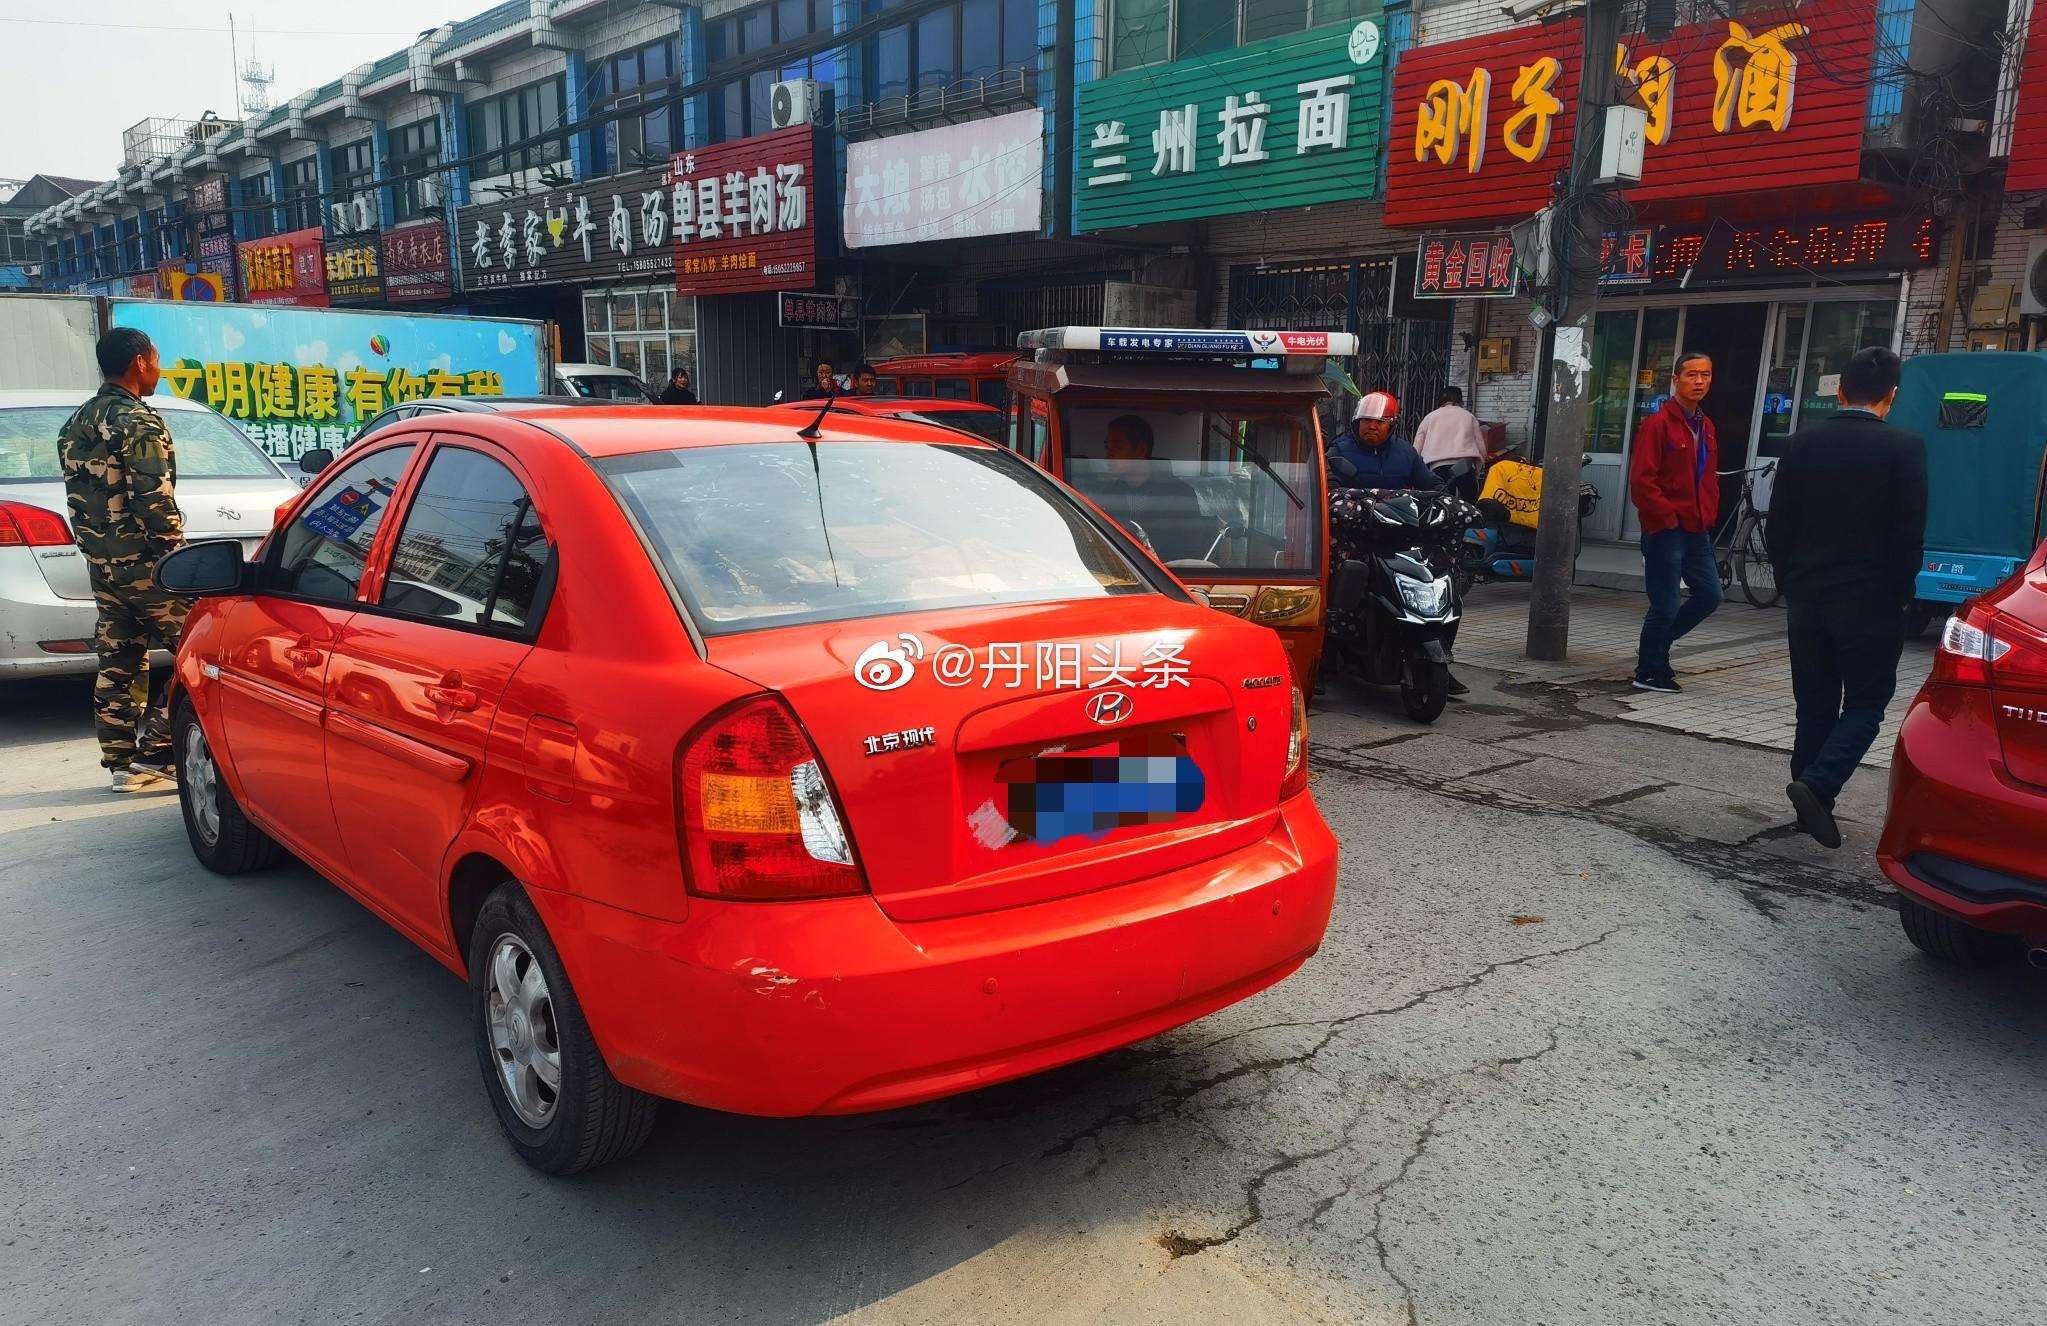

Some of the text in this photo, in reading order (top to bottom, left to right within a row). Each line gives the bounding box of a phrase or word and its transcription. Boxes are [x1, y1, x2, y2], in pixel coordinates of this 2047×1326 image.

[1088, 75, 1355, 186] 兰州拉面
[673, 153, 695, 176] 山东
[854, 157, 911, 218] 大娘
[919, 185, 951, 211] 汤包
[672, 164, 806, 243] 单县羊肉汤
[472, 190, 669, 270] 老李家 牛肉汤
[684, 251, 757, 274] 家常小炒 羊肉烩面
[1422, 241, 1511, 290] 黄金回收
[783, 298, 837, 323] 单县羊肉汤
[1107, 337, 1174, 348] 车载发电专家
[1287, 335, 1325, 347] 牛电光伏
[160, 358, 503, 420] 文明健康 有你有我
[863, 726, 936, 755] 北京现代
